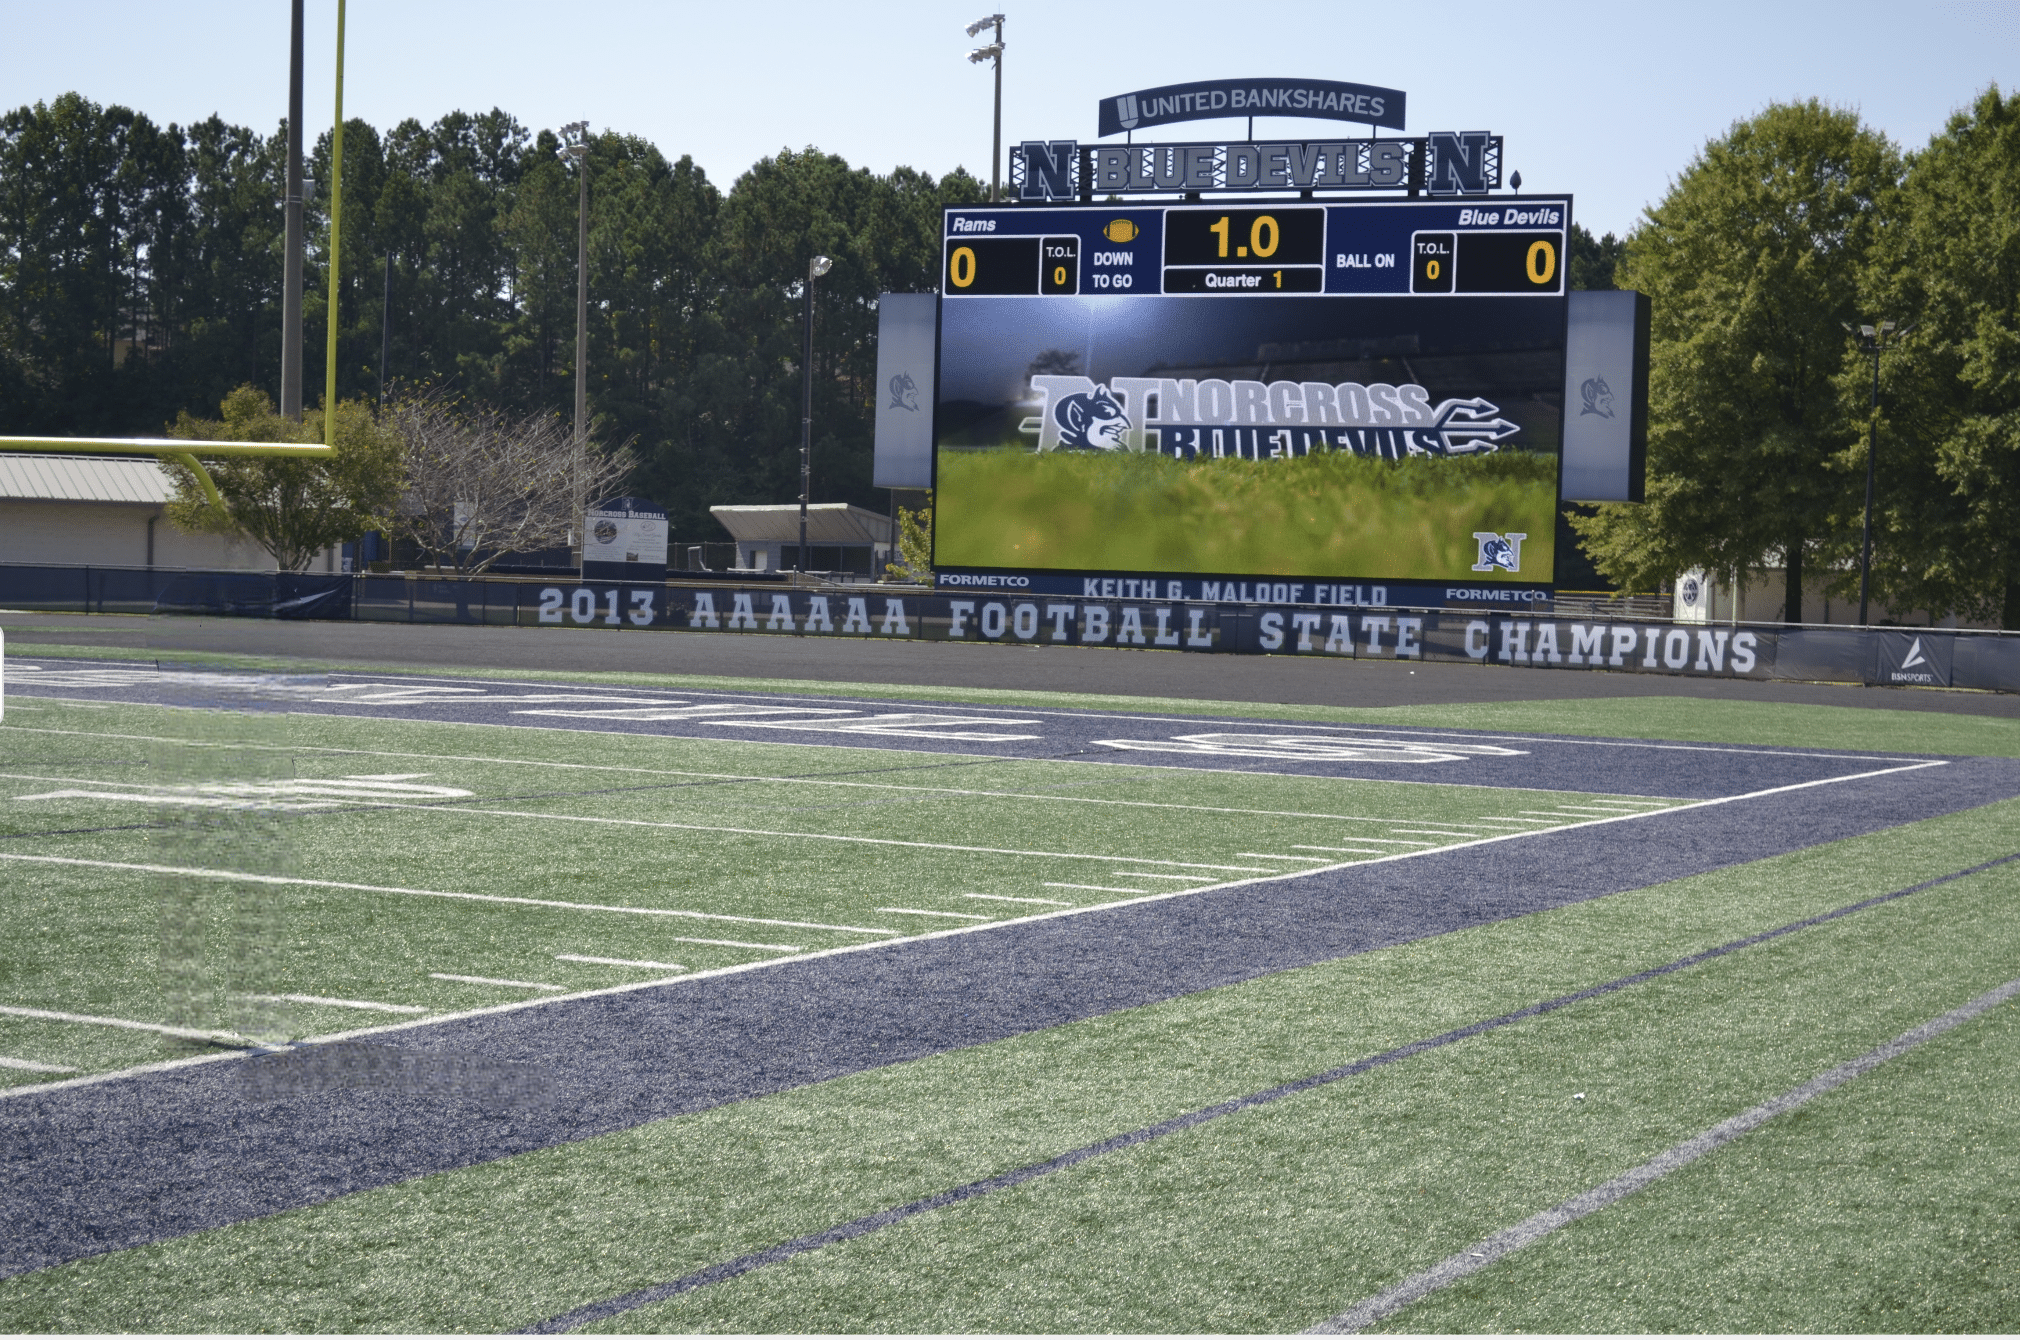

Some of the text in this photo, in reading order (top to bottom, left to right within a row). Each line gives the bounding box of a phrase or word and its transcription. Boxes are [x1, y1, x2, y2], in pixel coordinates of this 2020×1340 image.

[1142, 89, 1385, 118] UNITED BANKSHARES
[1021, 140, 1077, 200] N
[1097, 143, 1406, 191] BLUE DEVILS
[1427, 131, 1491, 195] N
[953, 217, 996, 232] Rams
[1458, 209, 1559, 225] Blue Devils
[1210, 216, 1279, 258] 1.0
[1046, 247, 1076, 258] T.O.L.
[1417, 243, 1450, 254] T.O.L.
[950, 247, 976, 288] 0
[1093, 252, 1133, 266] DOWN
[1336, 253, 1394, 268] BALL ON
[1526, 240, 1556, 284] 0
[1054, 266, 1066, 285] 0
[1205, 270, 1282, 289] Quarter 1
[1426, 260, 1440, 280] 0
[1092, 274, 1133, 288] TO GO
[1158, 378, 1430, 426] NORCROSS
[587, 508, 666, 520] NORCROSS BASEBALL
[940, 574, 1029, 587] FORMETCO
[1084, 578, 1156, 599] KEITH
[1202, 582, 1303, 604] MALOOF
[1314, 585, 1387, 606] FIELD
[1446, 588, 1547, 602] FORMETCO
[538, 588, 654, 626] 2013
[949, 601, 1212, 647] FOOTBALL
[1259, 612, 1421, 656] STATE
[1465, 619, 1757, 673] CHAMPIONS
